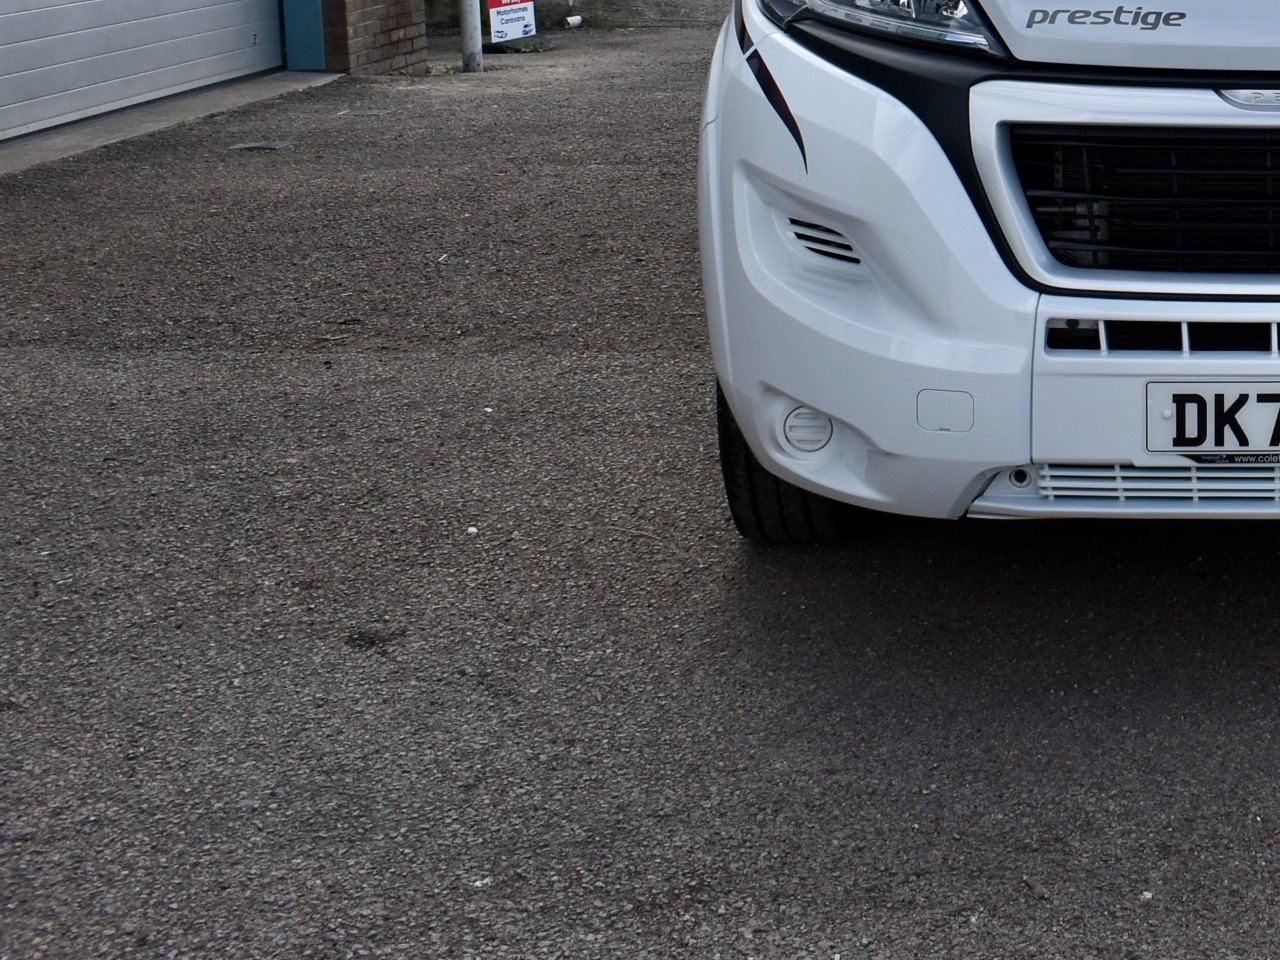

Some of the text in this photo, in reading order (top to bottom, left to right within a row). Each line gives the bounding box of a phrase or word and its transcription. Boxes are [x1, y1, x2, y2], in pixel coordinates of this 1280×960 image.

[497, 7, 528, 16] Motorhomes
[501, 16, 525, 25] Caravans
[1026, 5, 1187, 31] prestige
